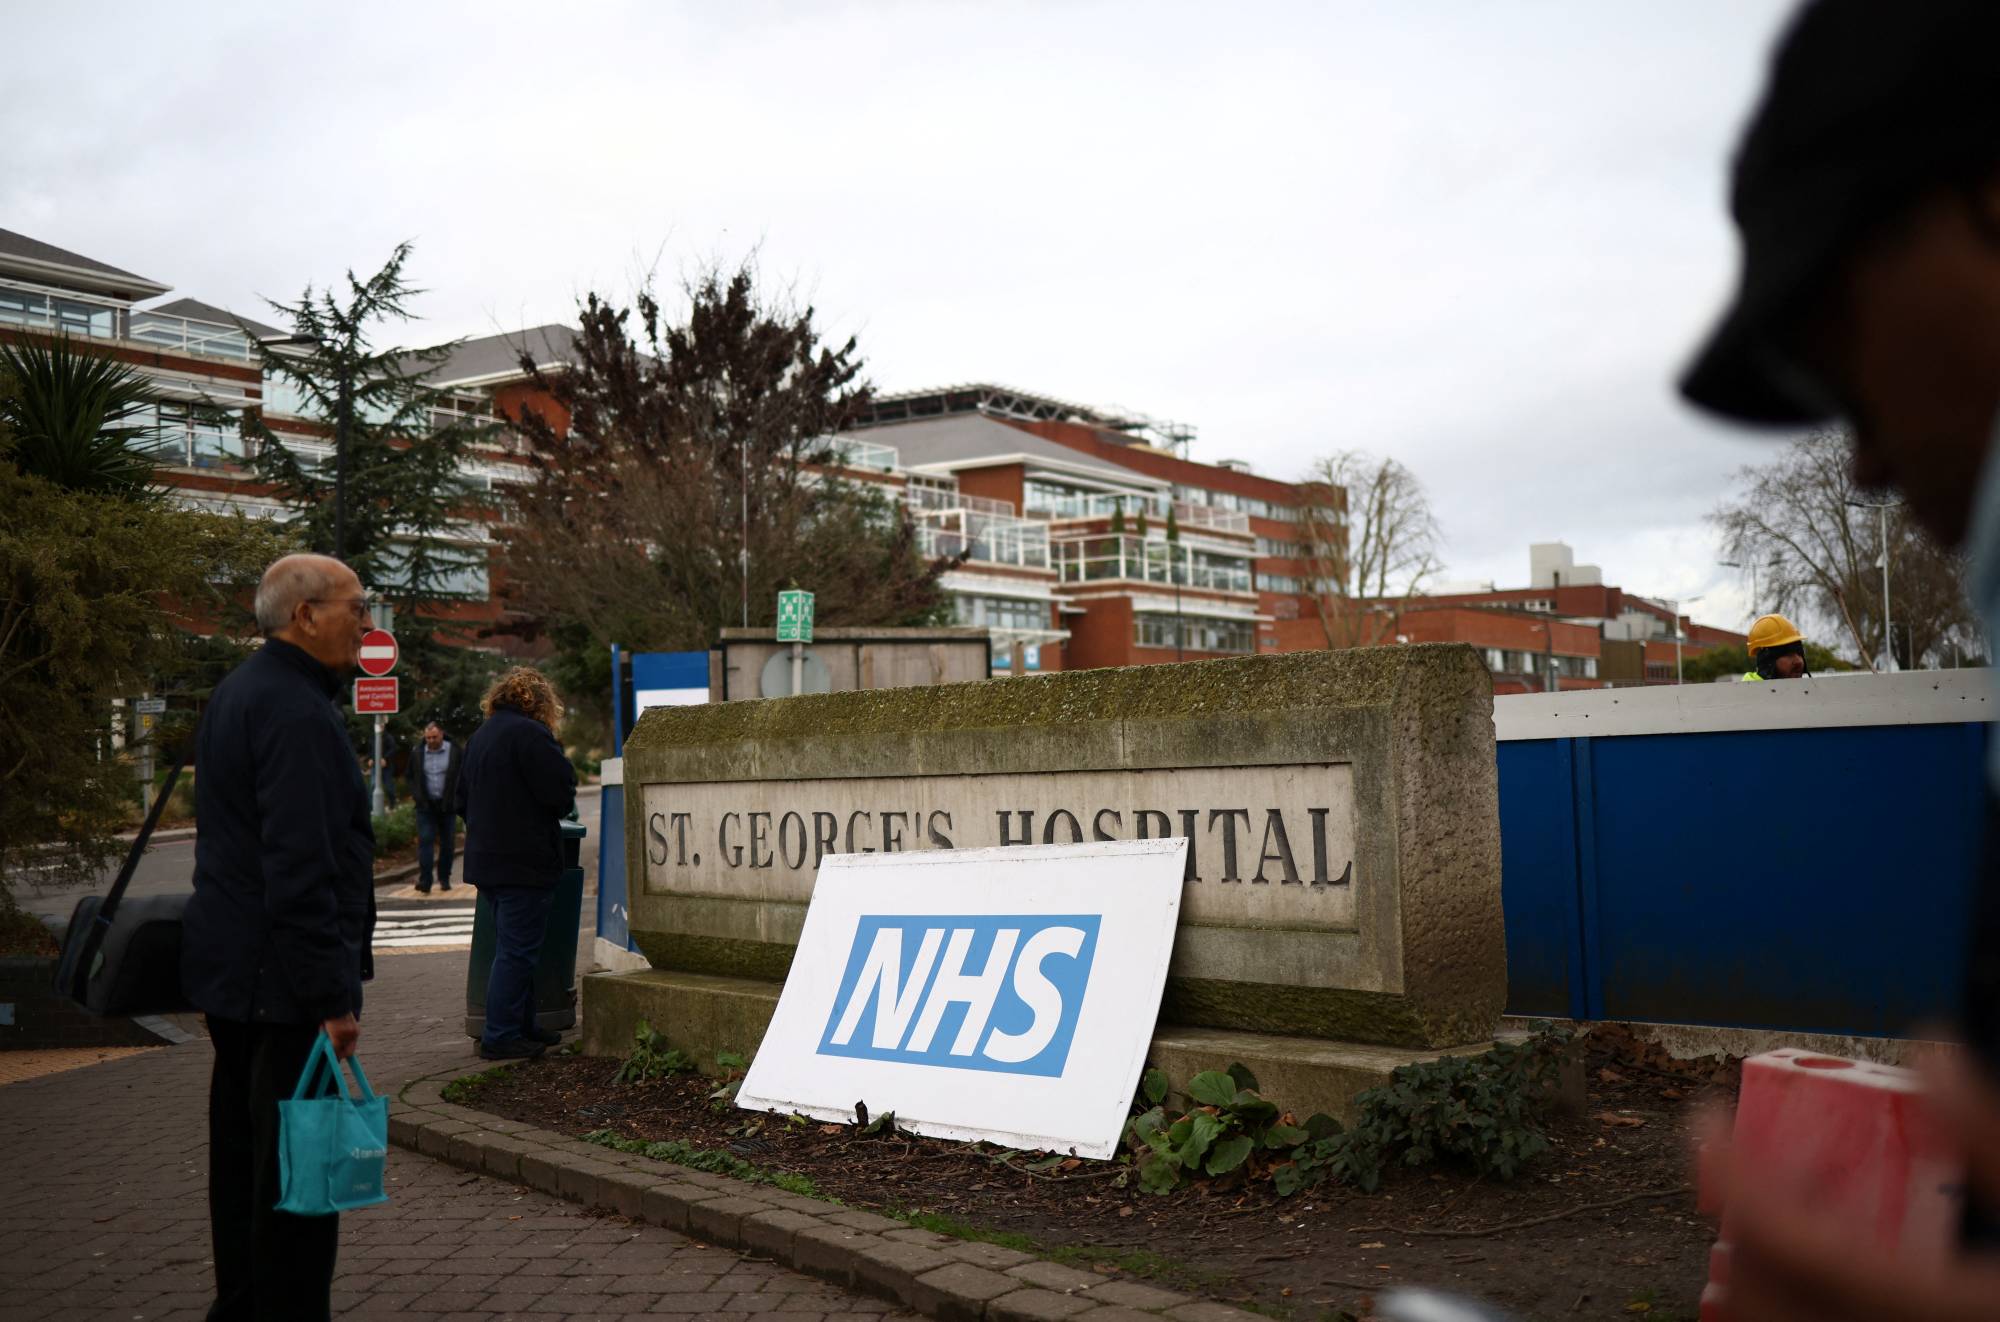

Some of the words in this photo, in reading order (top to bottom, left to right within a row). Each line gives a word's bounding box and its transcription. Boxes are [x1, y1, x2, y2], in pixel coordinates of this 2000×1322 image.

[648, 811, 701, 867] ST.
[718, 809, 954, 870] GEORGE'S
[829, 926, 1087, 1063] NHS
